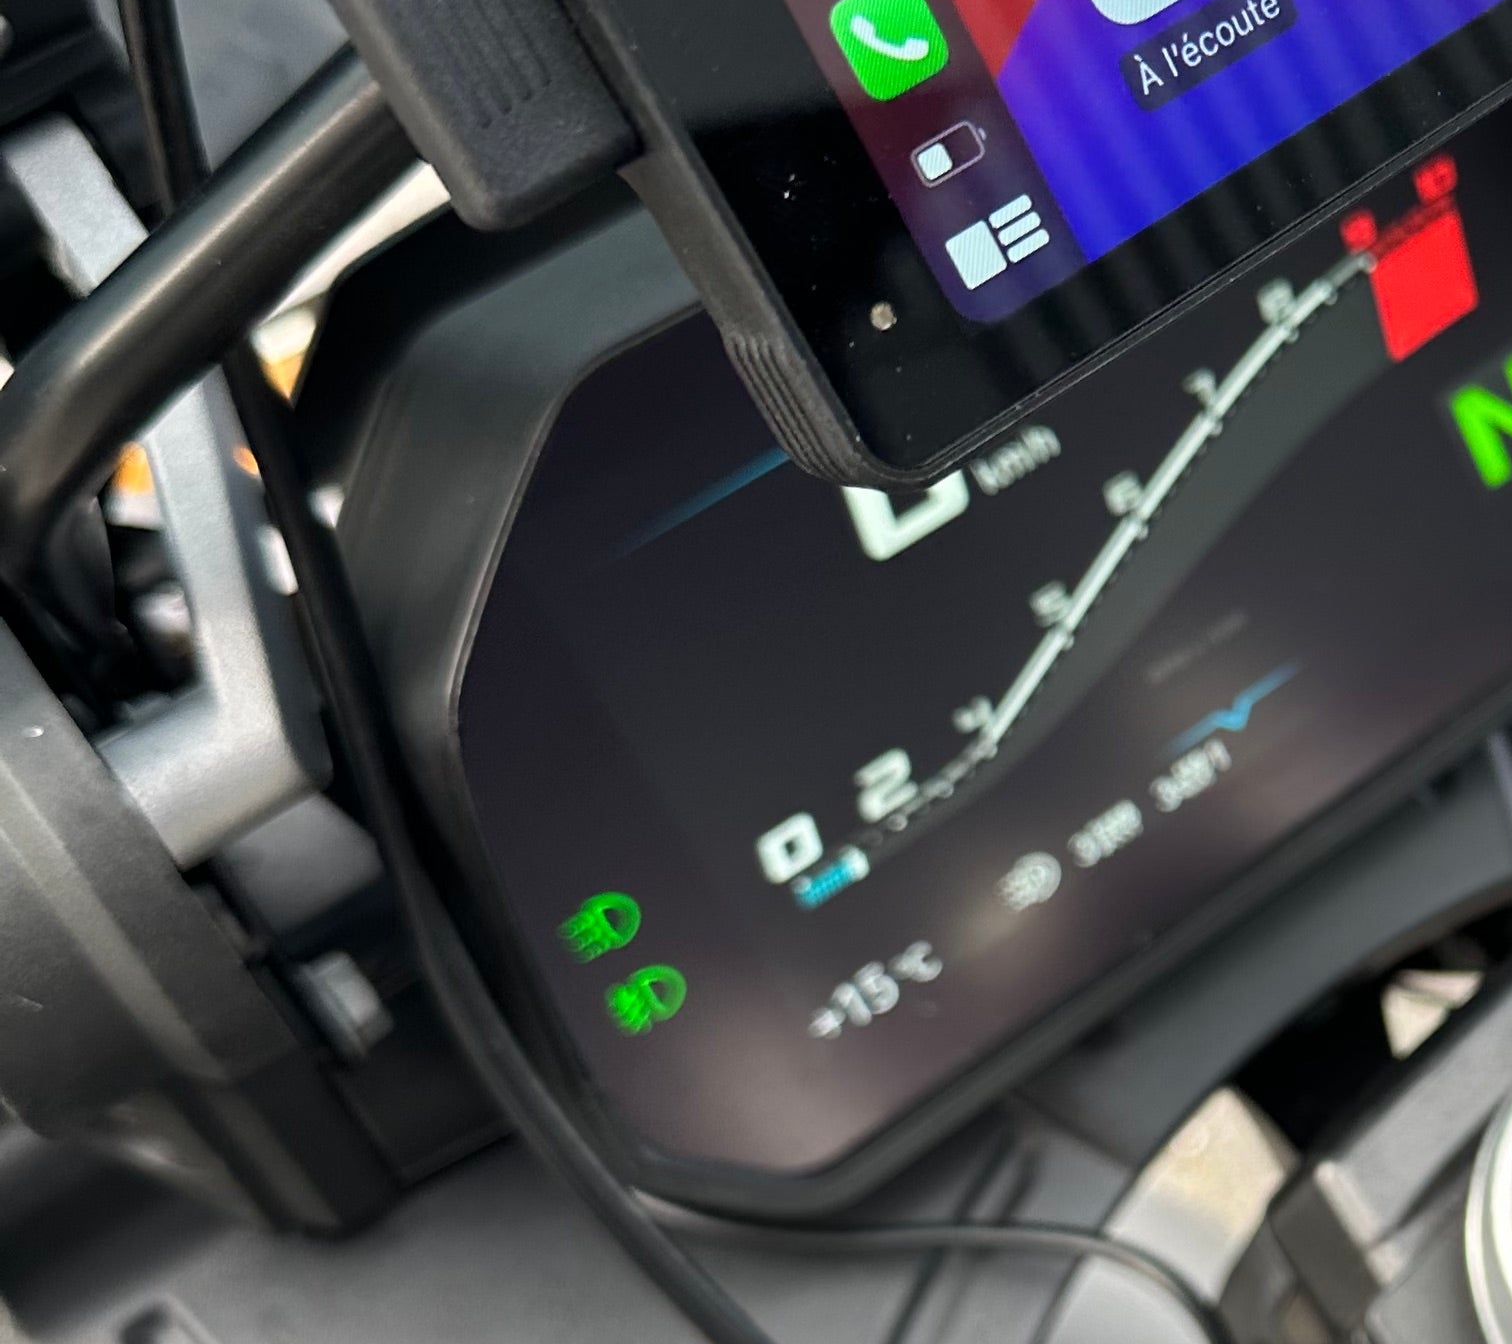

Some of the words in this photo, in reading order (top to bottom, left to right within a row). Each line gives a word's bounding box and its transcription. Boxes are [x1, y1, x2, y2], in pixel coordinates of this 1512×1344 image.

[1133, 52, 1164, 97] À
[853, 746, 918, 824] 2
[757, 811, 824, 885] 0
